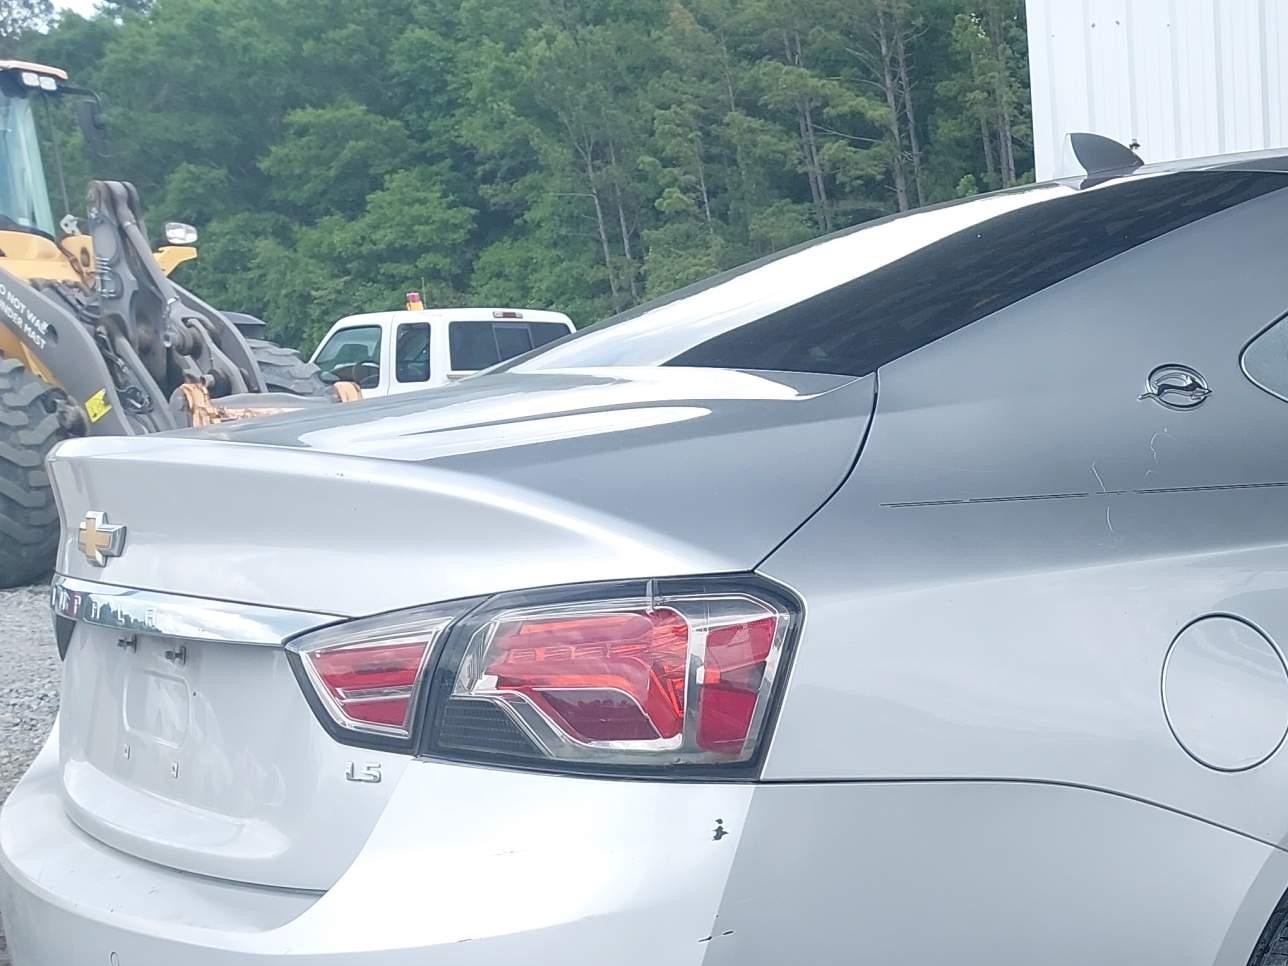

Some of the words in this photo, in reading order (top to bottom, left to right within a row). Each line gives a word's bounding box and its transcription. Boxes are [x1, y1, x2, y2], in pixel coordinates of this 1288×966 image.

[7, 291, 27, 314] NOT
[0, 300, 23, 328] NDER
[23, 323, 46, 349] MAST
[345, 761, 382, 784] LS
